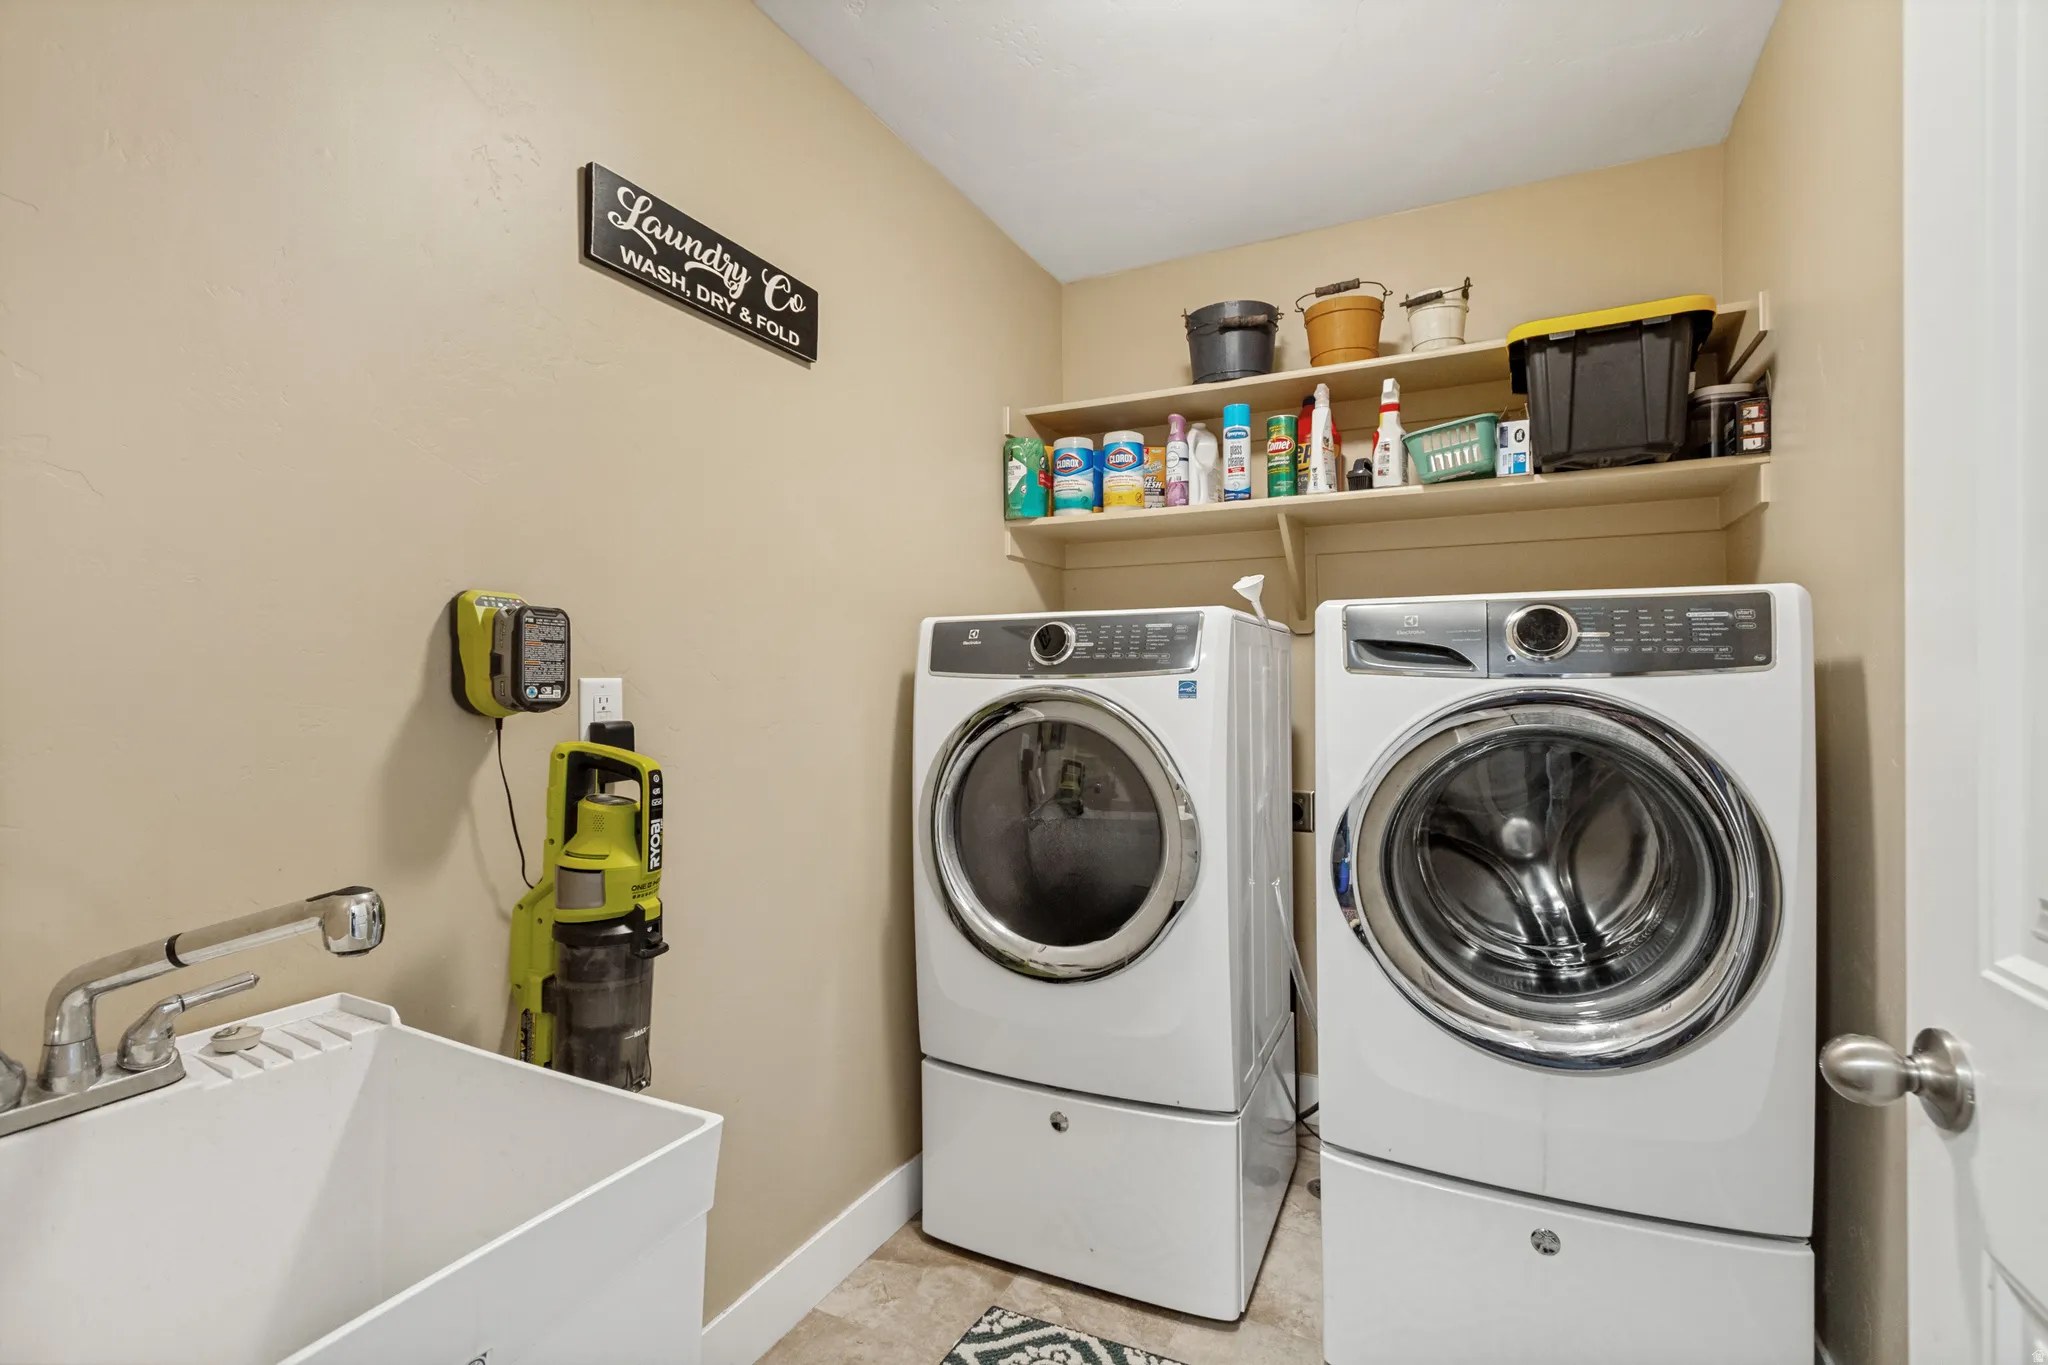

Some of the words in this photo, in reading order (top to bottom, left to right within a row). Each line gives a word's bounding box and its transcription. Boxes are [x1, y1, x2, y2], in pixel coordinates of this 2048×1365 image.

[607, 186, 751, 299] Laundry
[762, 268, 806, 312] Co
[619, 245, 691, 297] WASH,
[696, 284, 736, 315] DRY
[739, 306, 752, 324] &
[756, 314, 800, 346] FOLD
[1109, 454, 1133, 464] CLOROX
[1267, 440, 1290, 452] Comet
[1056, 459, 1080, 469] CLOROX
[650, 818, 660, 870] RYOBI
